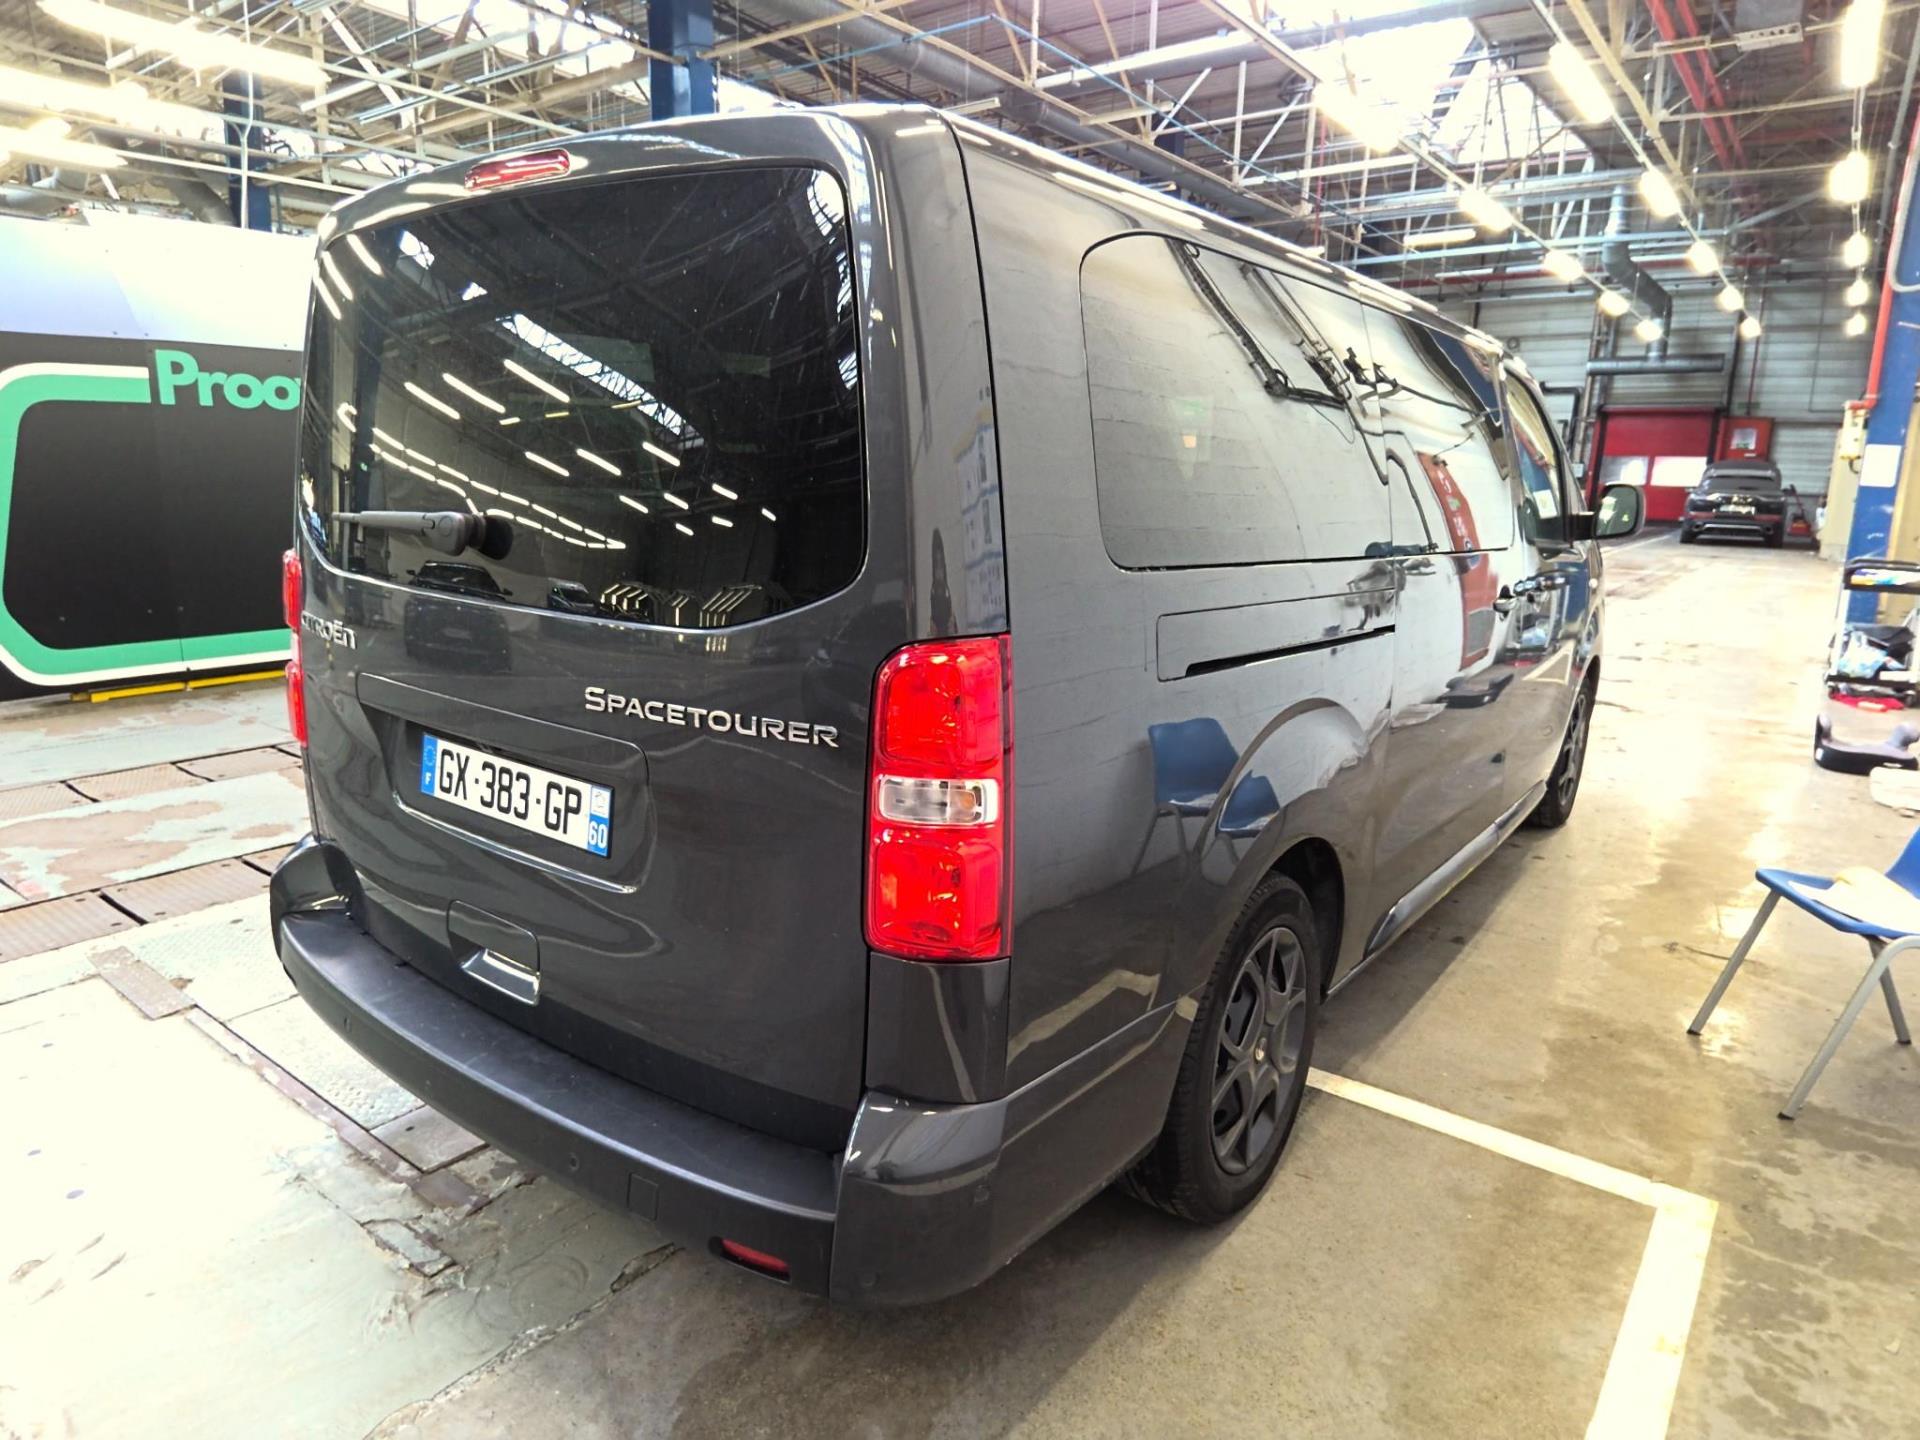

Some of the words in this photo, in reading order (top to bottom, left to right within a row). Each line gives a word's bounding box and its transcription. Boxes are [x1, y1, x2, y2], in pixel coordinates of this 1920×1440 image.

[155, 349, 302, 411] Proo
[424, 772, 432, 785] F
[439, 748, 582, 835] GX-383-GP
[588, 820, 607, 849] 60
